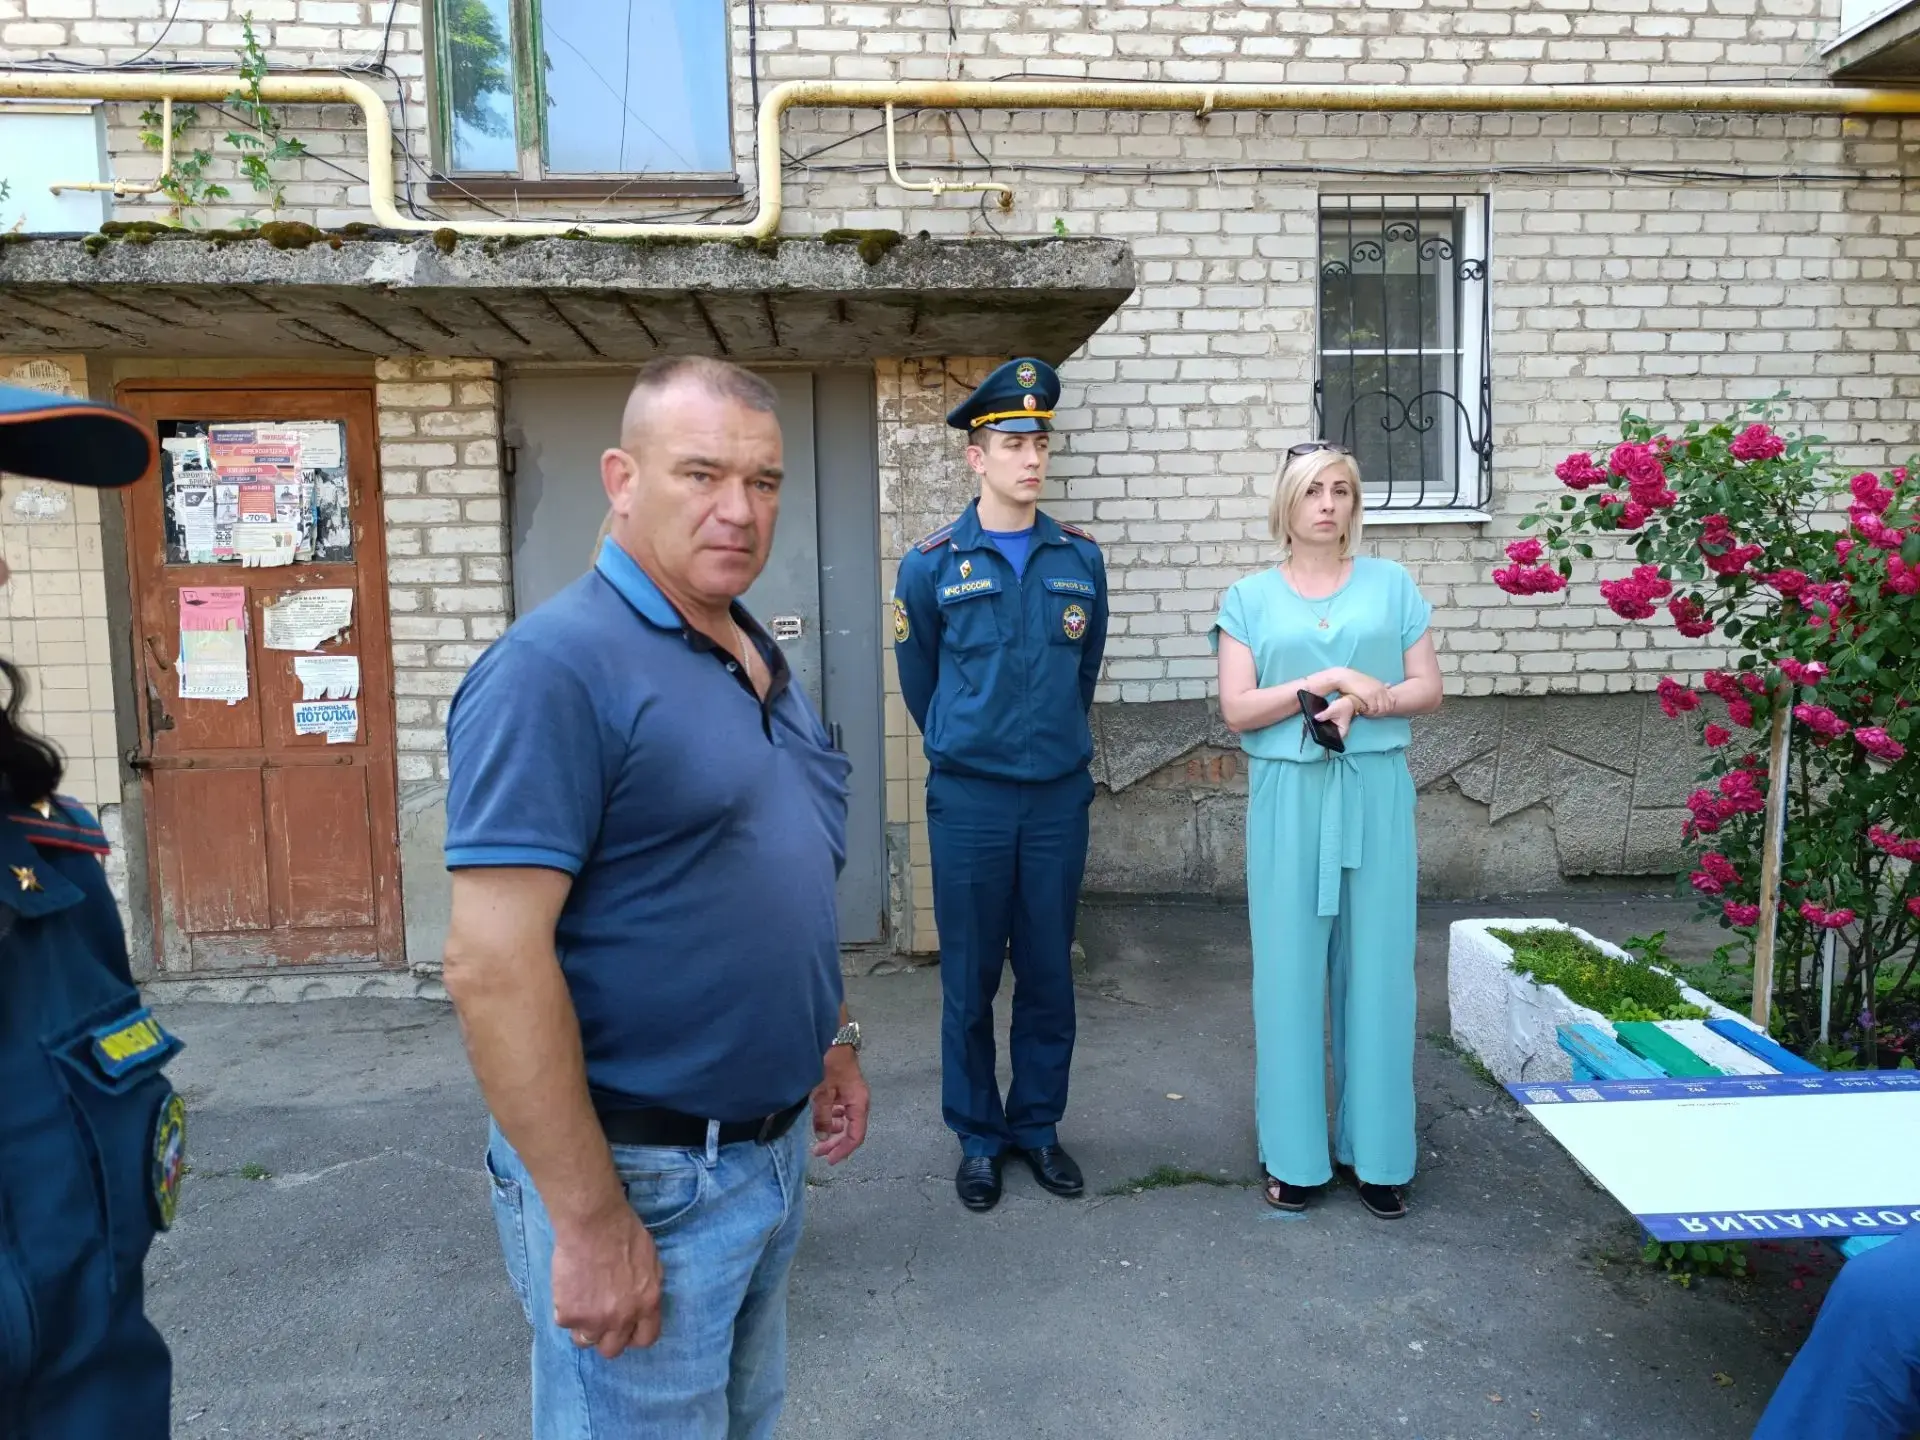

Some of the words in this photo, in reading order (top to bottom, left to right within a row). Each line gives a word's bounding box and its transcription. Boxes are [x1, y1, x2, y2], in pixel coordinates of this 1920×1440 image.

[944, 585, 961, 597] МЧС
[961, 579, 992, 593] РОССИИ
[296, 709, 356, 723] ПОТОЛКИ
